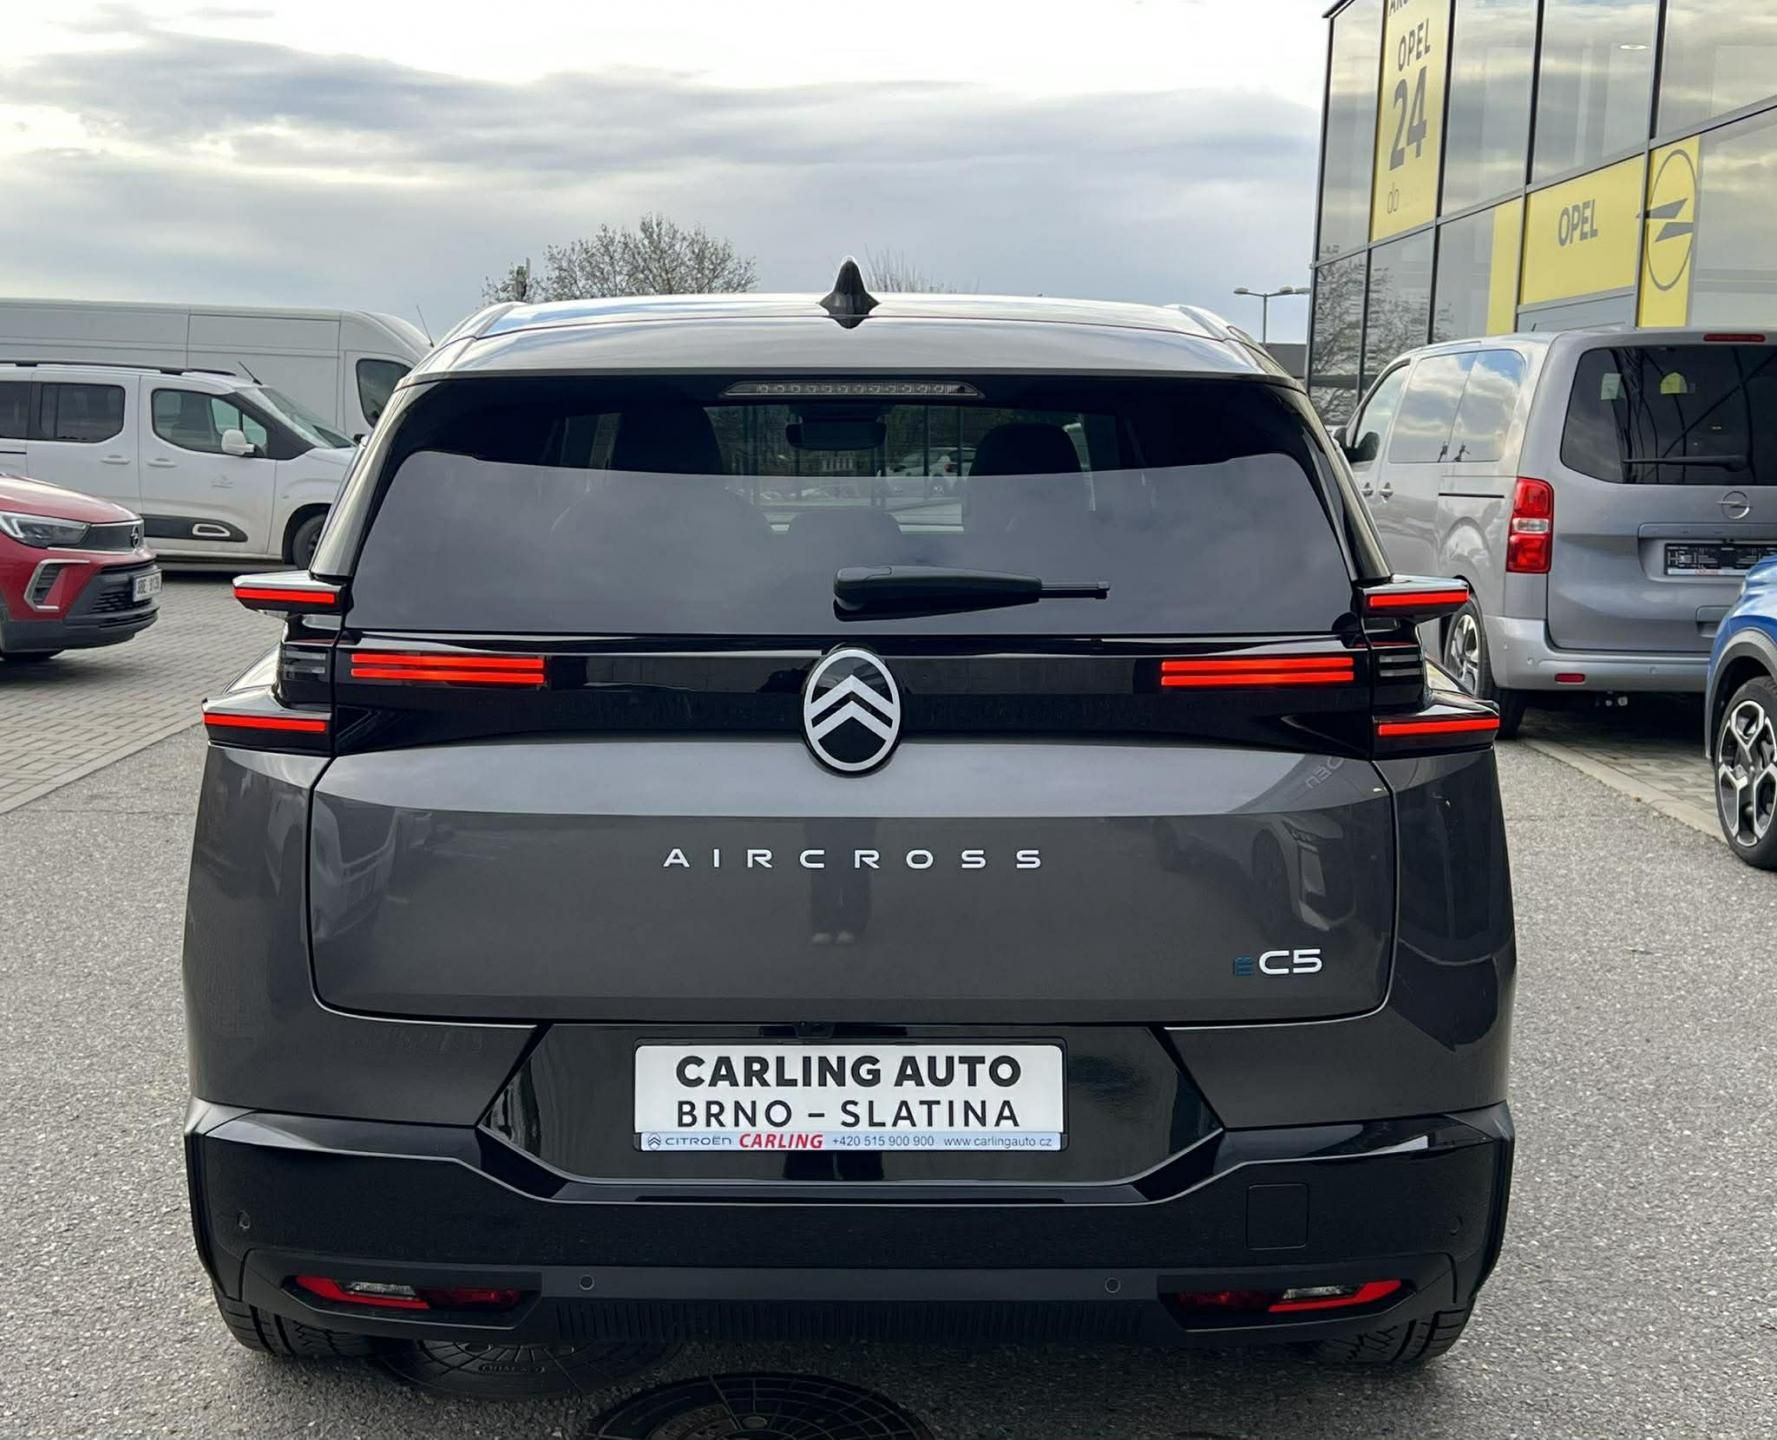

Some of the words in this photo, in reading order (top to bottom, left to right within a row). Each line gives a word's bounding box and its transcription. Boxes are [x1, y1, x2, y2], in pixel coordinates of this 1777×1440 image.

[1398, 18, 1431, 72] OPEL
[1390, 66, 1427, 170] 24
[1558, 198, 1599, 247] OPEL
[663, 848, 1041, 869] AIRCROSS
[676, 1055, 881, 1088] CARLING
[894, 1055, 1022, 1088] AUTO
[677, 1100, 792, 1128] BRNO
[841, 1100, 1020, 1128] SLATINA
[738, 1133, 823, 1149] CARLING
[832, 1135, 860, 1147] +420
[864, 1135, 885, 1147] 515
[888, 1135, 910, 1147] 900
[913, 1135, 934, 1147] 900
[944, 1135, 1052, 1149] www.carlingauto.cz
